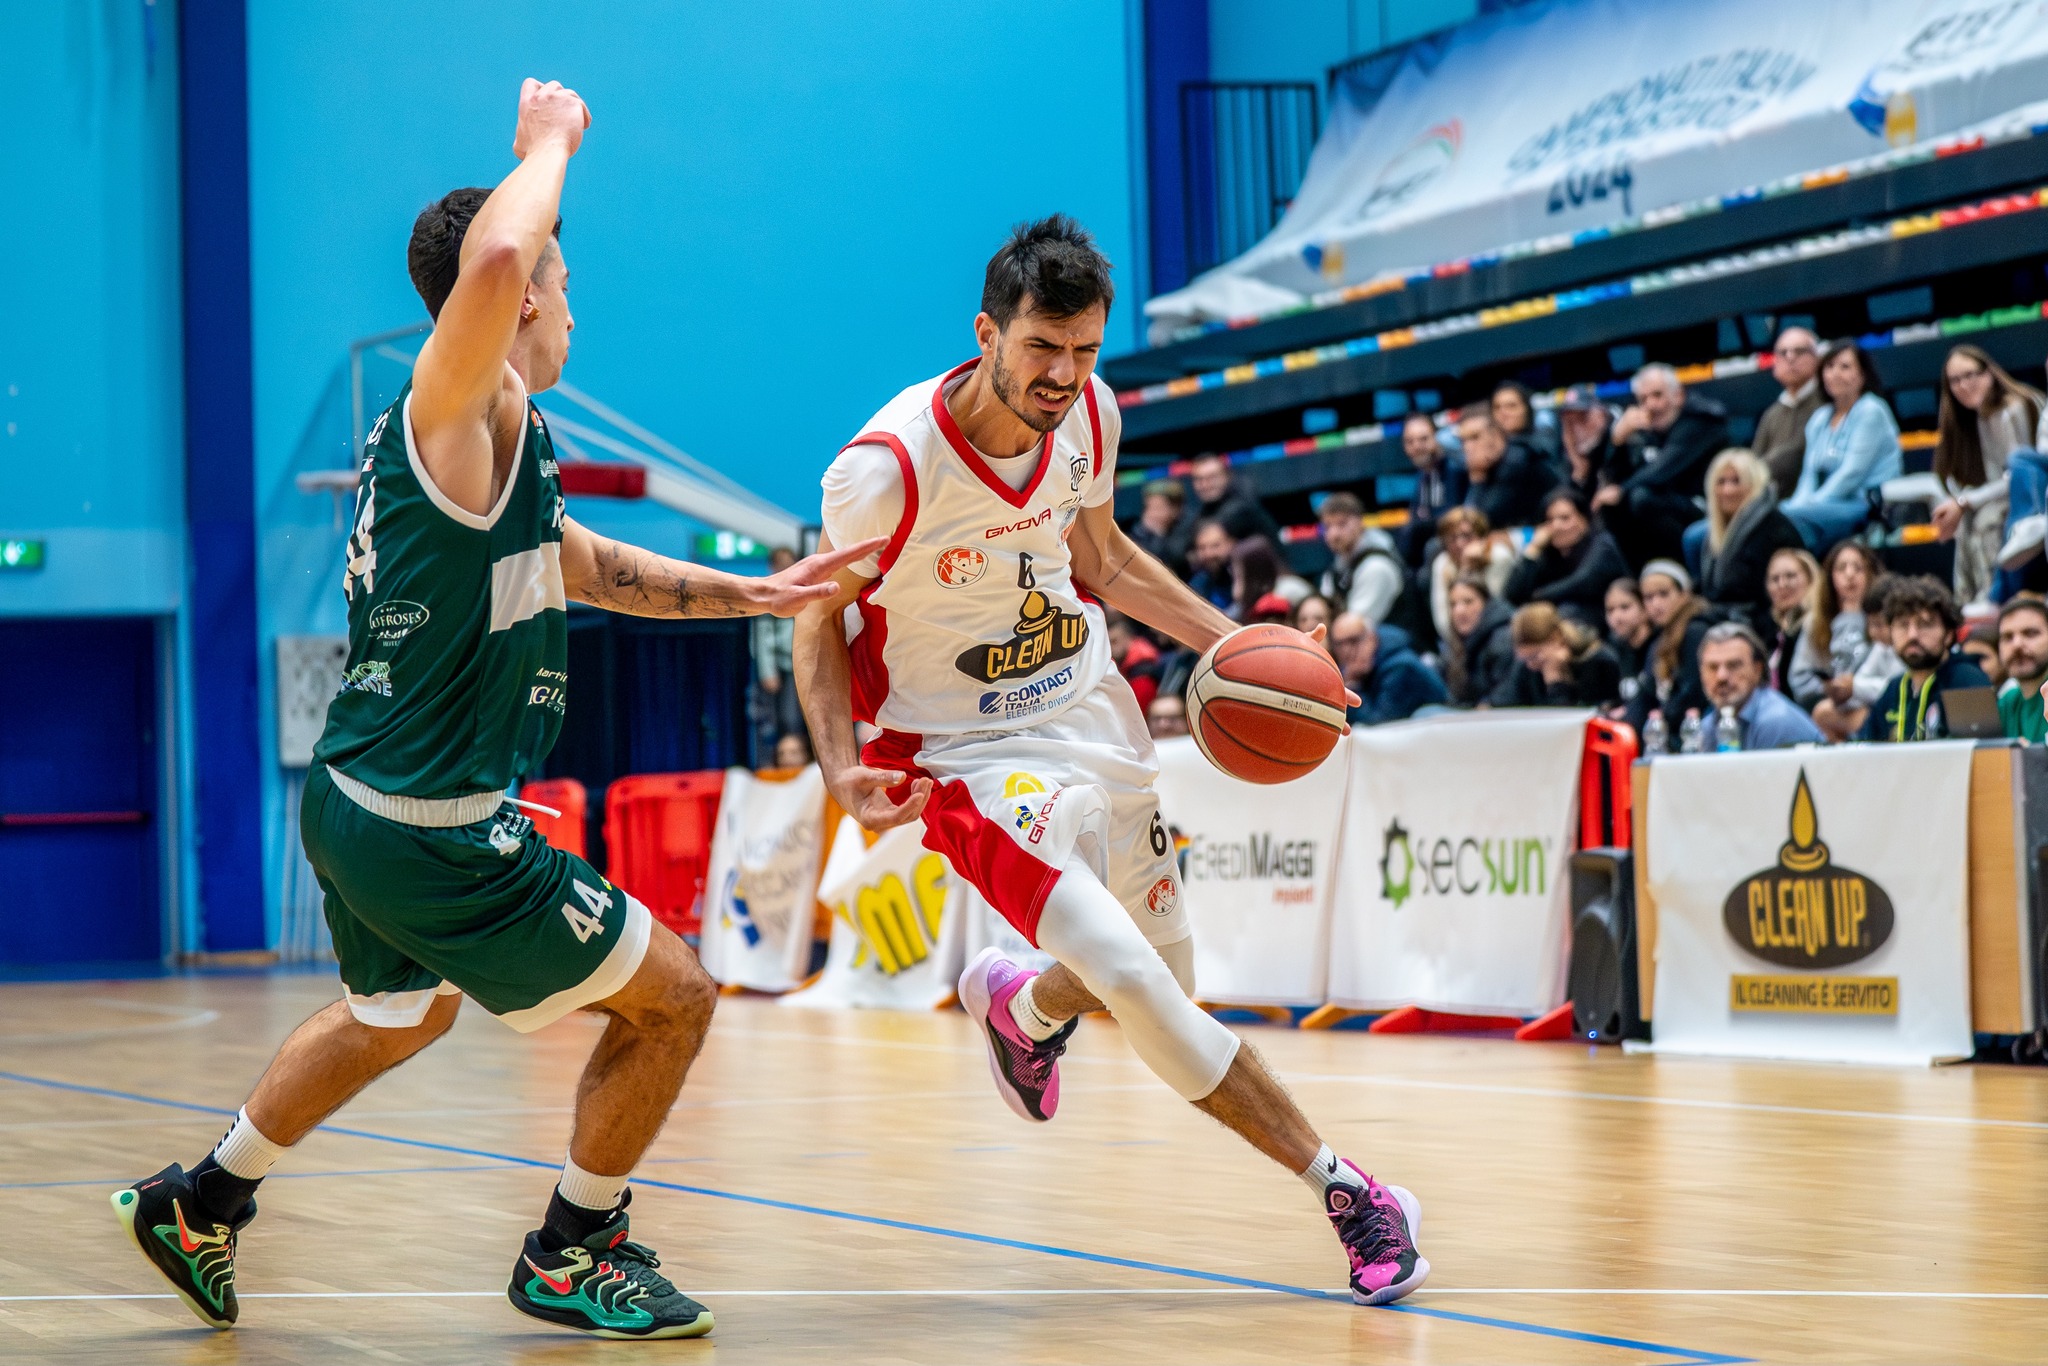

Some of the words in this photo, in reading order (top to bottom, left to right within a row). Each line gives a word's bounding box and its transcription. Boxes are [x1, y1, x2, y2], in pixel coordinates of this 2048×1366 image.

[985, 508, 1052, 539] GIVOVA
[1017, 551, 1036, 590] 6
[986, 623, 1054, 679] CLEAN
[1061, 612, 1086, 649] UP
[1005, 666, 1073, 703] CONTACT
[1005, 696, 1041, 711] ITALIA
[1006, 703, 1046, 720] ELECTRIC
[1149, 809, 1167, 857] 6
[1417, 836, 1545, 896] secsun
[561, 878, 613, 944] 44
[1747, 878, 1828, 957] CLEAN
[1831, 878, 1867, 947] UP
[1749, 981, 1818, 1008] CLEANING
[1833, 983, 1891, 1009] SERVITO
